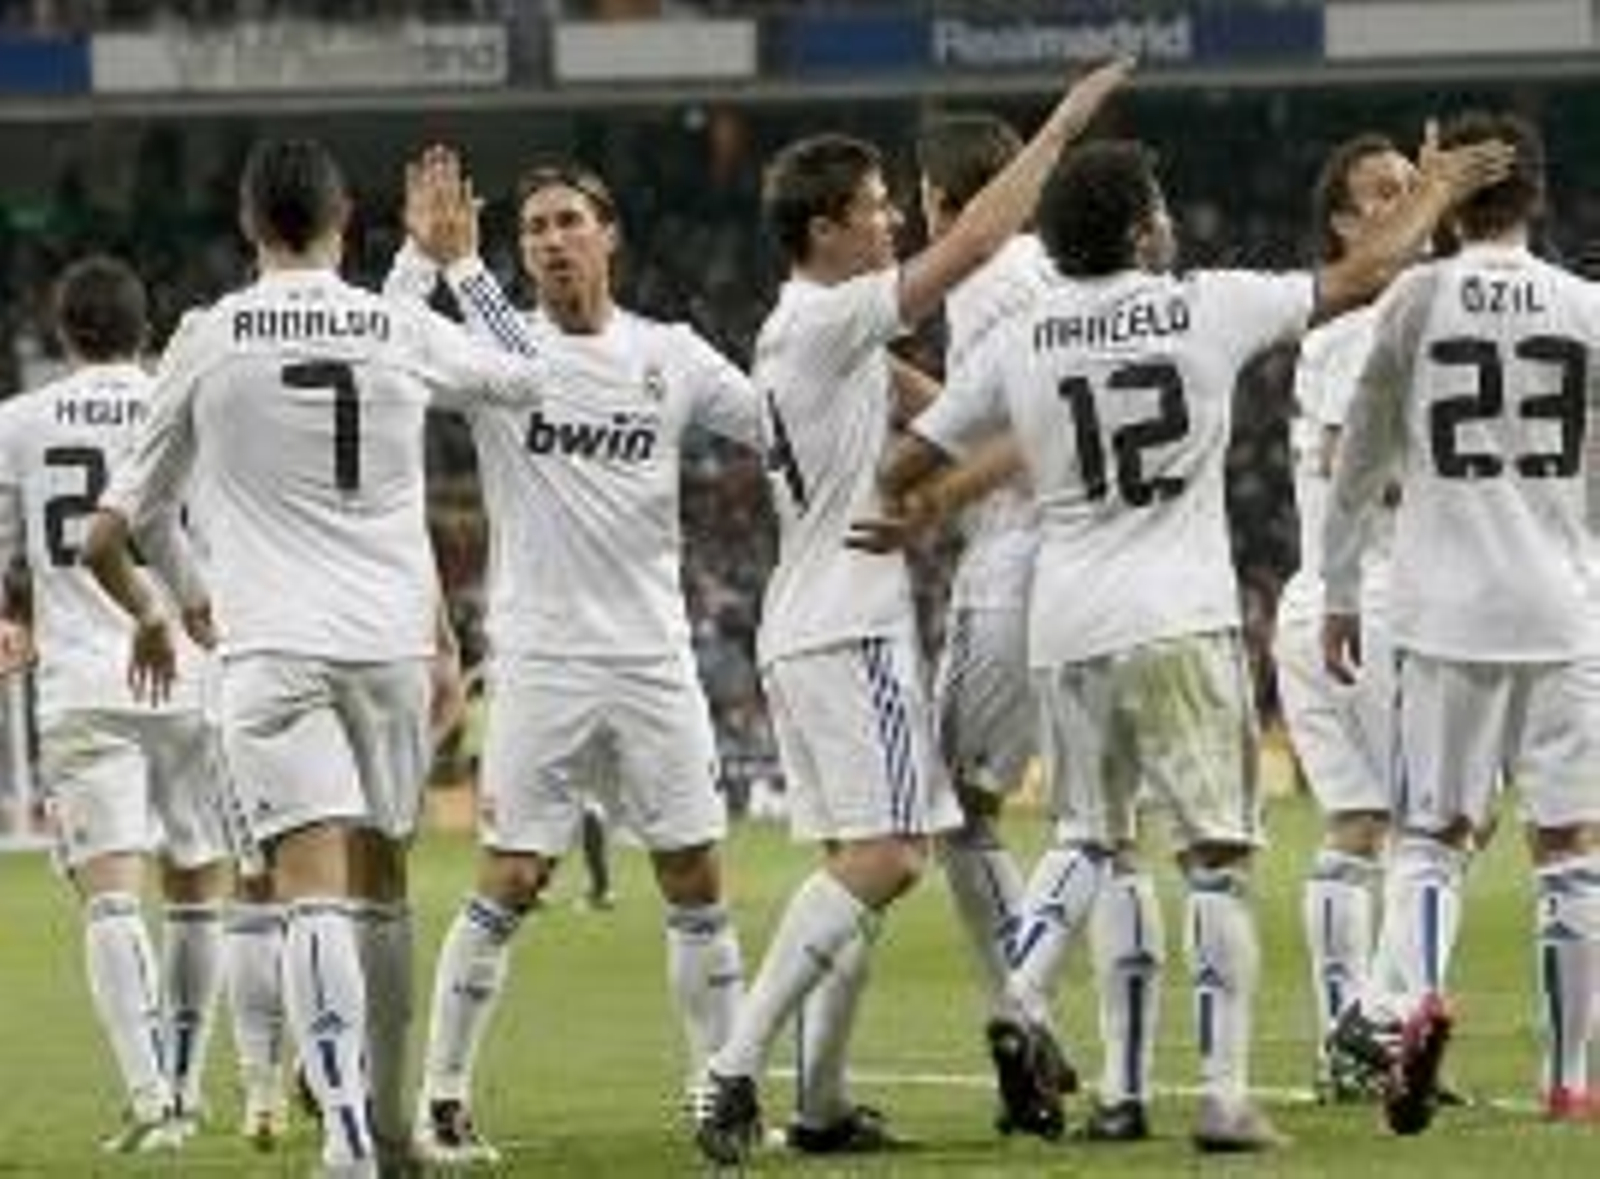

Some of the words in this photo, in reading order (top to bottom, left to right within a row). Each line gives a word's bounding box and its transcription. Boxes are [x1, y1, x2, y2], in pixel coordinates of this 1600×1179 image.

[55, 399, 148, 425] HIGUA
[281, 360, 360, 491] 7
[526, 411, 656, 461] bwin
[1058, 363, 1190, 506] 12
[1431, 335, 1587, 478] 23
[44, 448, 110, 566] 2
